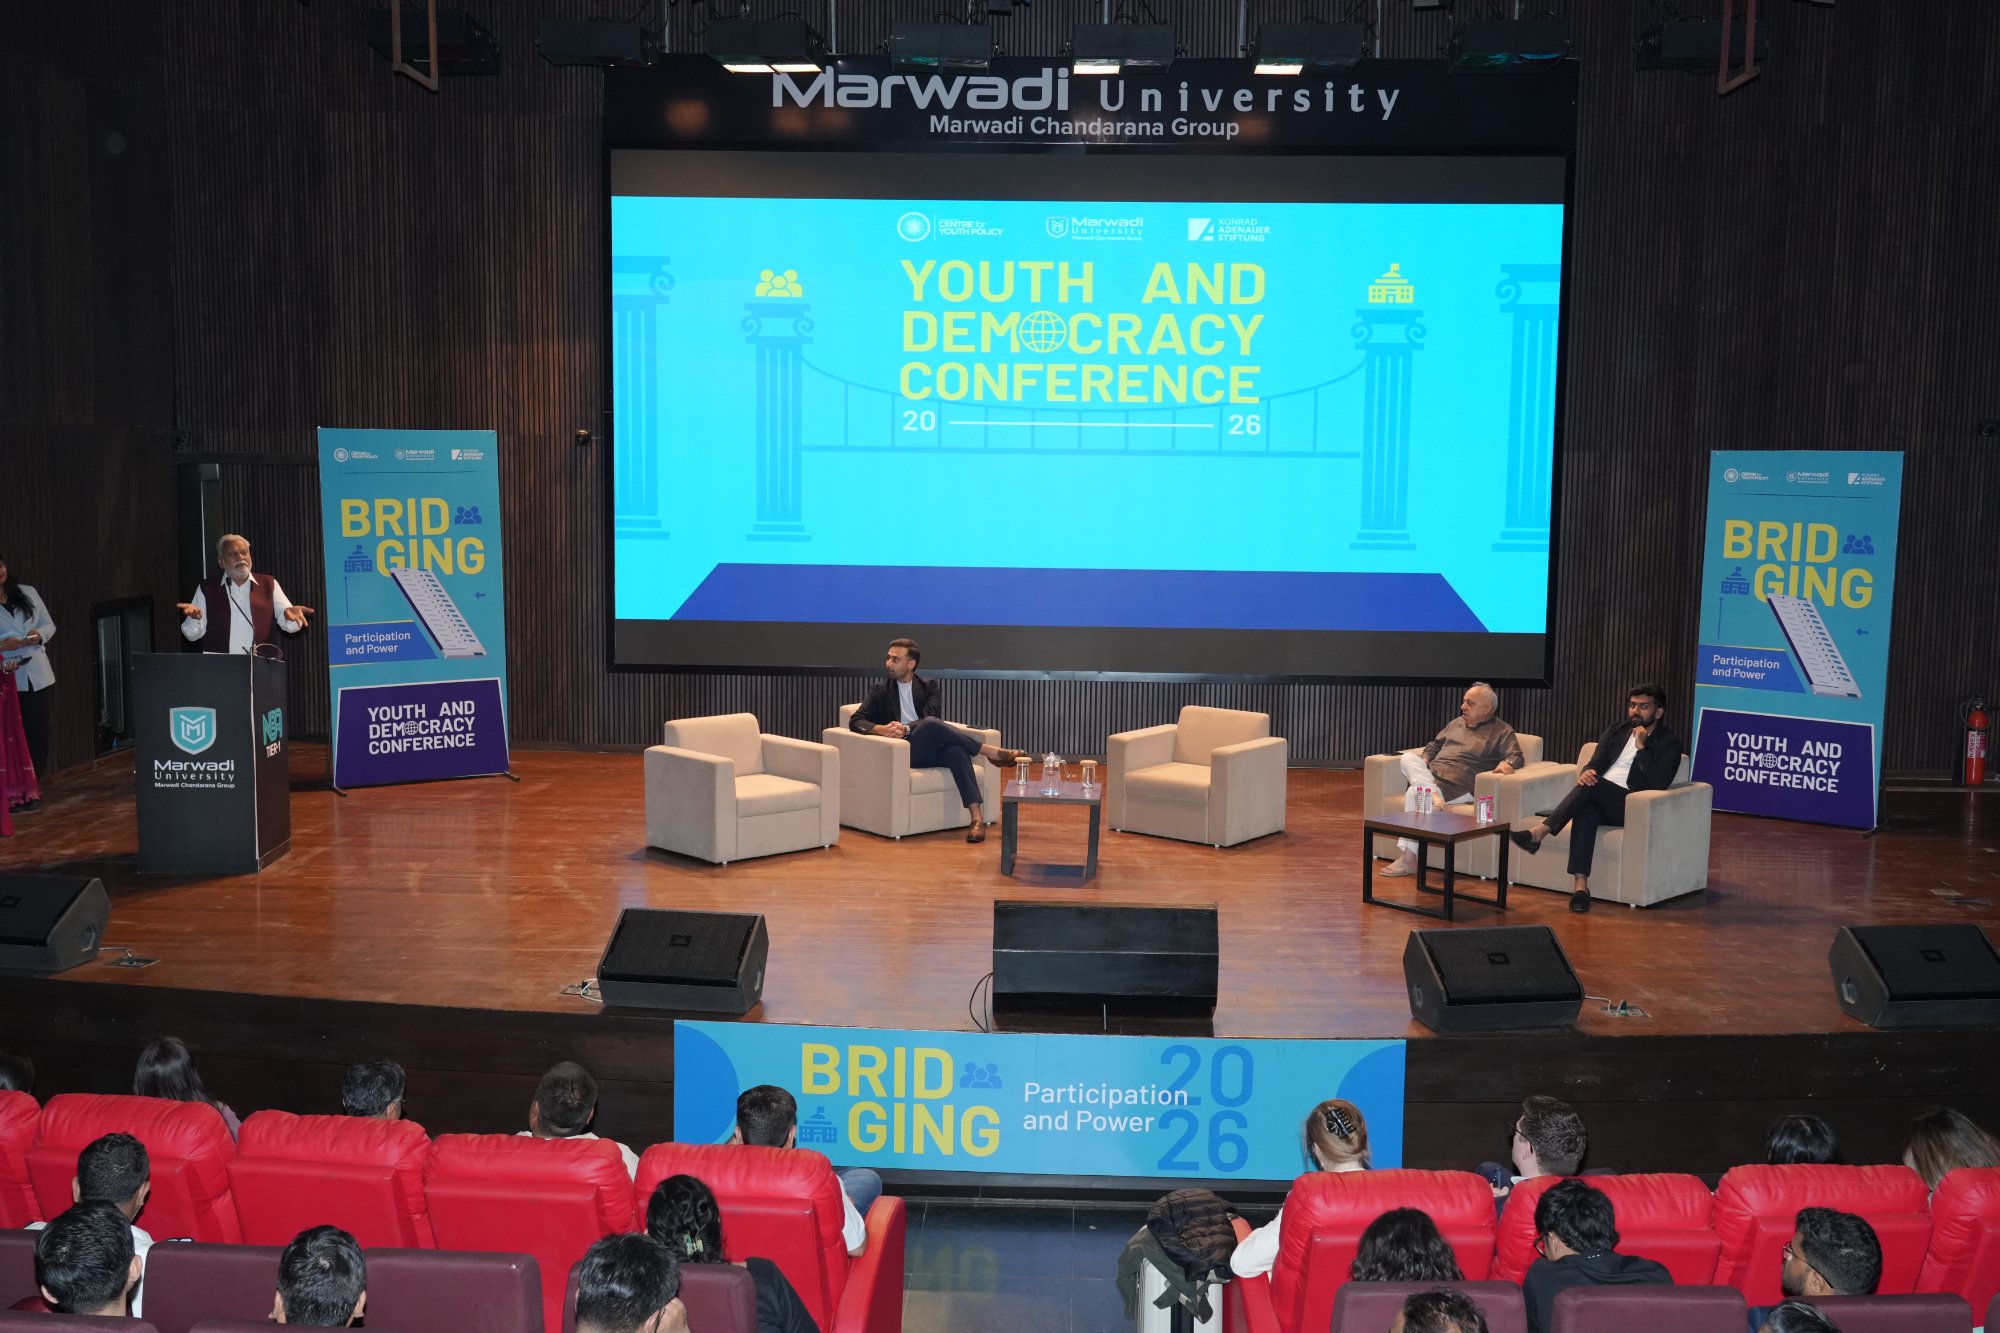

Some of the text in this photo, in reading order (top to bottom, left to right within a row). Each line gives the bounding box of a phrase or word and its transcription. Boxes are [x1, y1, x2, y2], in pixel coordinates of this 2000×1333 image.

[772, 65, 1399, 121] Marwadi University
[929, 115, 1240, 140] Marwadi Chandarana Group
[938, 220, 974, 228] CENTRE
[939, 227, 1004, 236] YOUTH POLICY
[1072, 216, 1144, 227] Marwadi
[1217, 226, 1271, 234] ADENAUER
[1218, 217, 1258, 226] KONRAD
[1217, 233, 1265, 242] STIFTUNG
[900, 259, 1266, 305] YOUTH AND
[899, 361, 1261, 404] CONFERENCE
[902, 410, 1261, 435] 20 26
[341, 497, 450, 537] BRID
[1723, 519, 1838, 563] BRID
[376, 537, 485, 577] GING
[1754, 563, 1873, 609] GING
[345, 631, 411, 644] Participation
[345, 644, 399, 655] and Power
[1712, 668, 1766, 680] and Power
[1713, 654, 1780, 669] Participation
[368, 700, 475, 722] YOUTH AND
[368, 733, 475, 755] CONFERENCE
[1727, 732, 1842, 759] YOUTH AND
[154, 760, 235, 771] Marwadi
[154, 771, 235, 782] University
[1724, 767, 1839, 793] CONFERENCE
[802, 1043, 954, 1100] BRID
[1160, 1044, 1254, 1107] 20
[1024, 1082, 1189, 1109] Participation
[848, 1101, 1000, 1157] GING
[1023, 1110, 1155, 1132] and Power
[1157, 1109, 1249, 1173] 26
